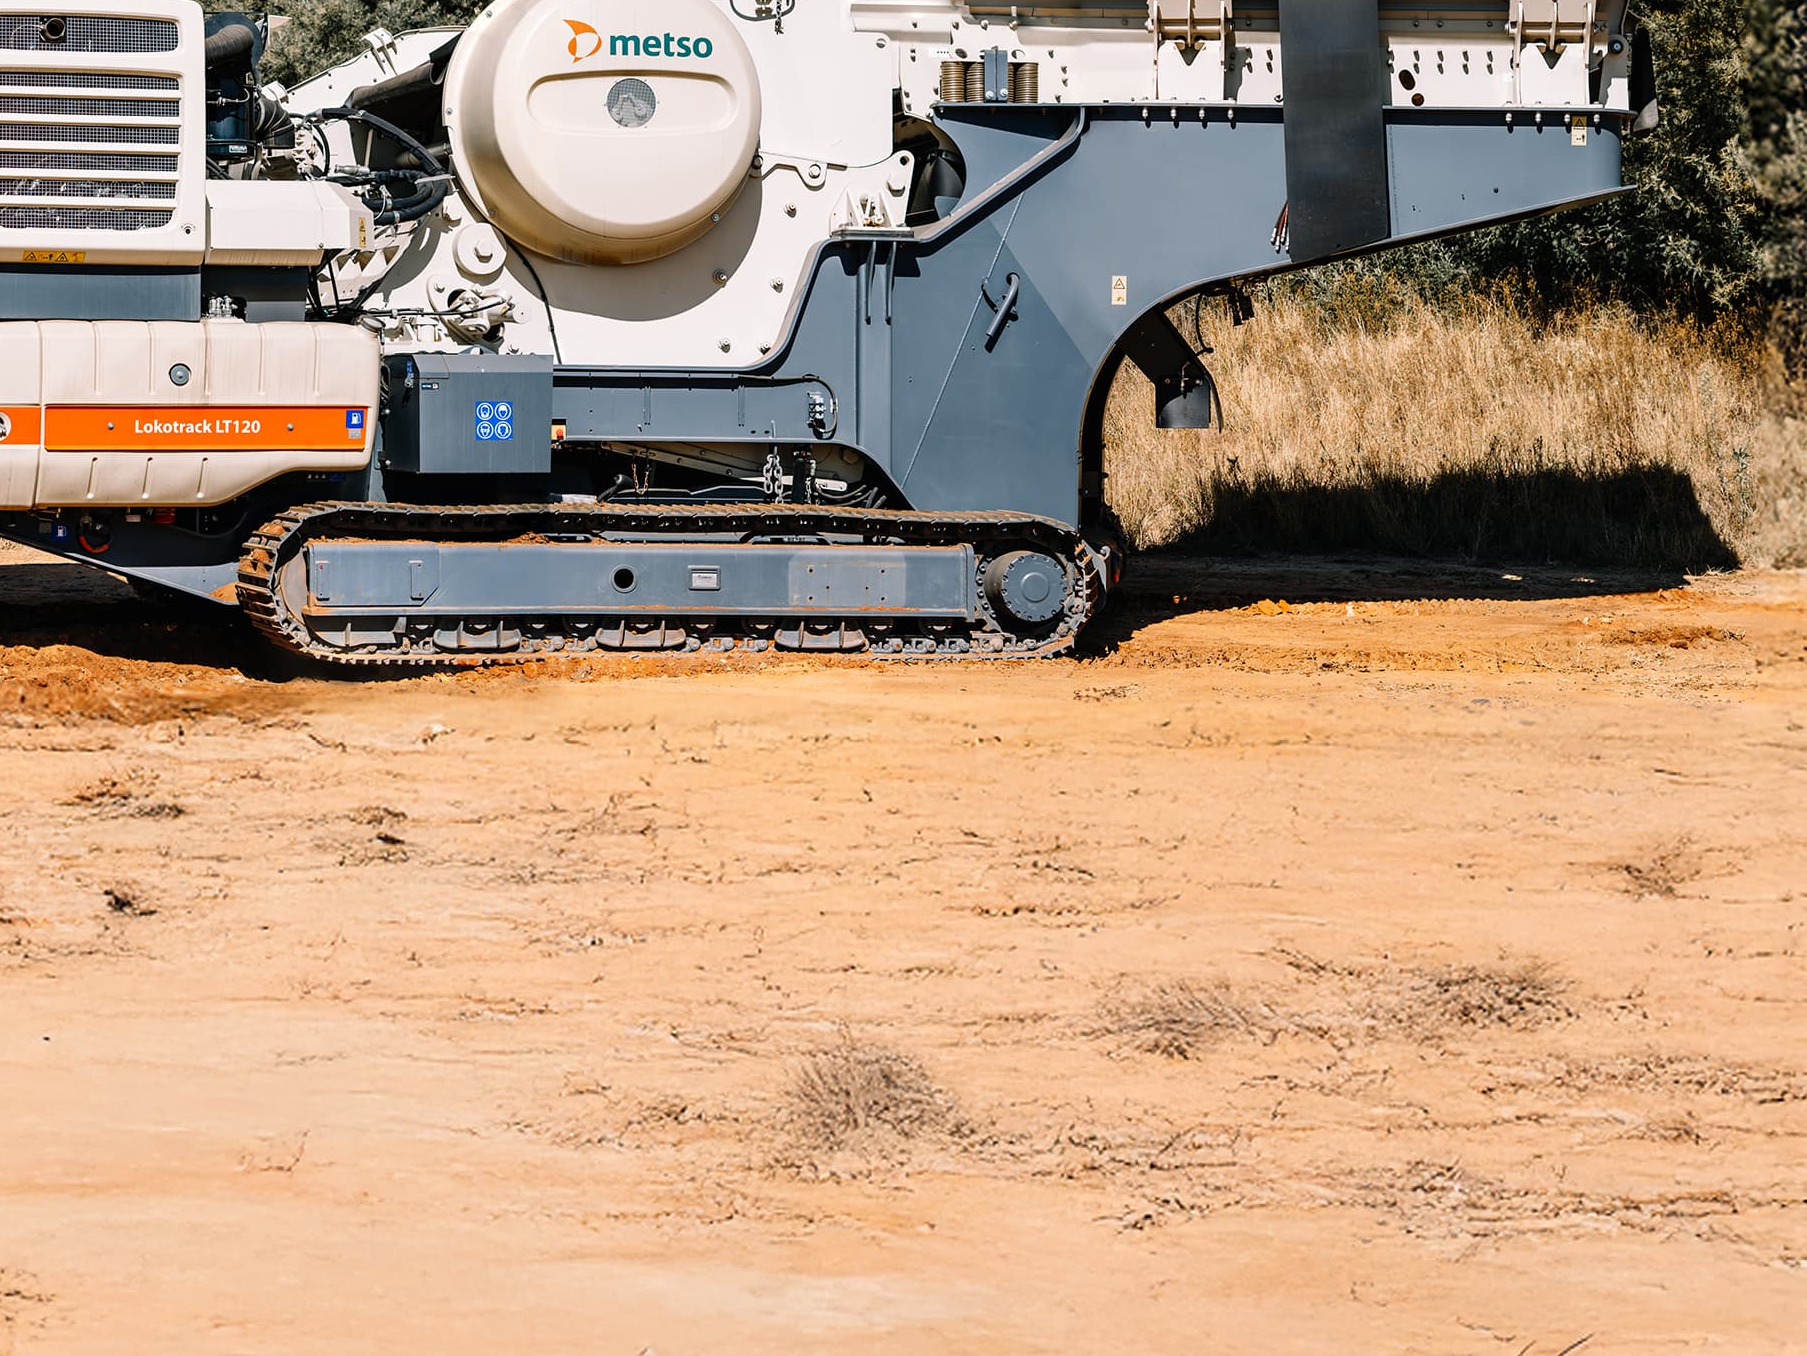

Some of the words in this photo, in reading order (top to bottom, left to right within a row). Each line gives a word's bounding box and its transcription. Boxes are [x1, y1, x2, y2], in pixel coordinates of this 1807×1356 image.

[609, 32, 713, 59] metso
[134, 419, 212, 434] Lokotrack
[215, 419, 261, 434] LT120
